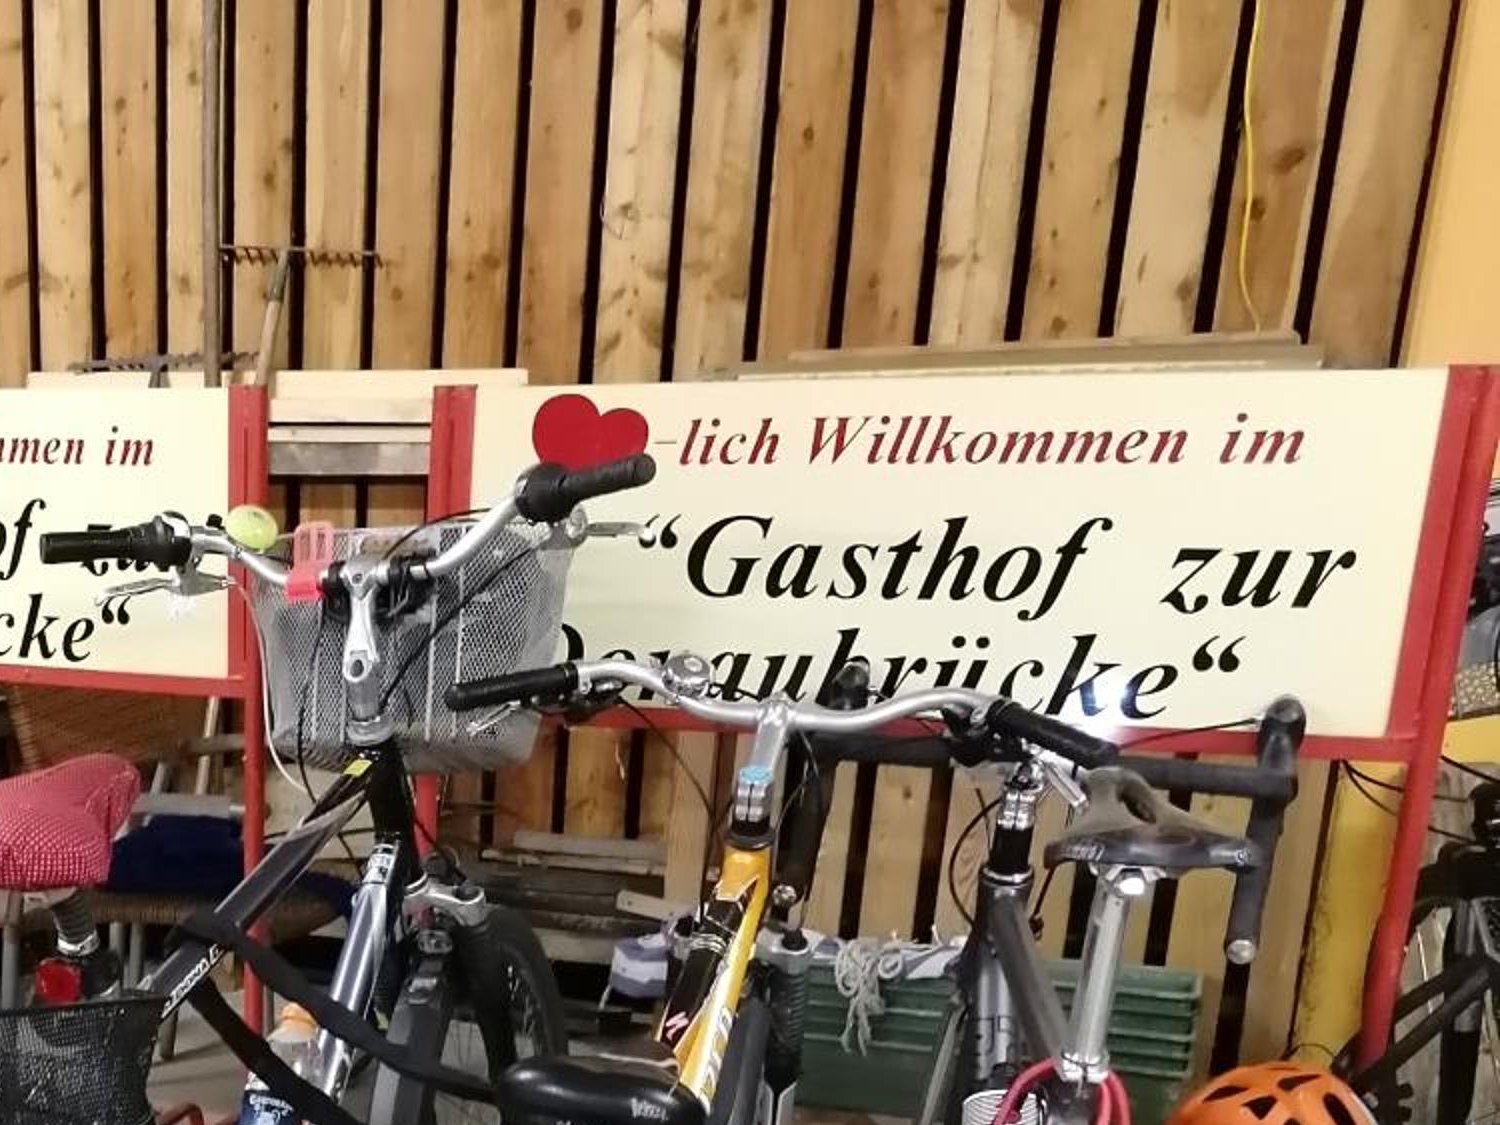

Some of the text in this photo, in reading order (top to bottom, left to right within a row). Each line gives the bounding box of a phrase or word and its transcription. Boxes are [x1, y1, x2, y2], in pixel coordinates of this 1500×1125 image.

[104, 425, 154, 467] im
[807, 415, 1190, 465] Willkommen
[1218, 412, 1304, 465] im
[1161, 545, 1358, 615] zur
